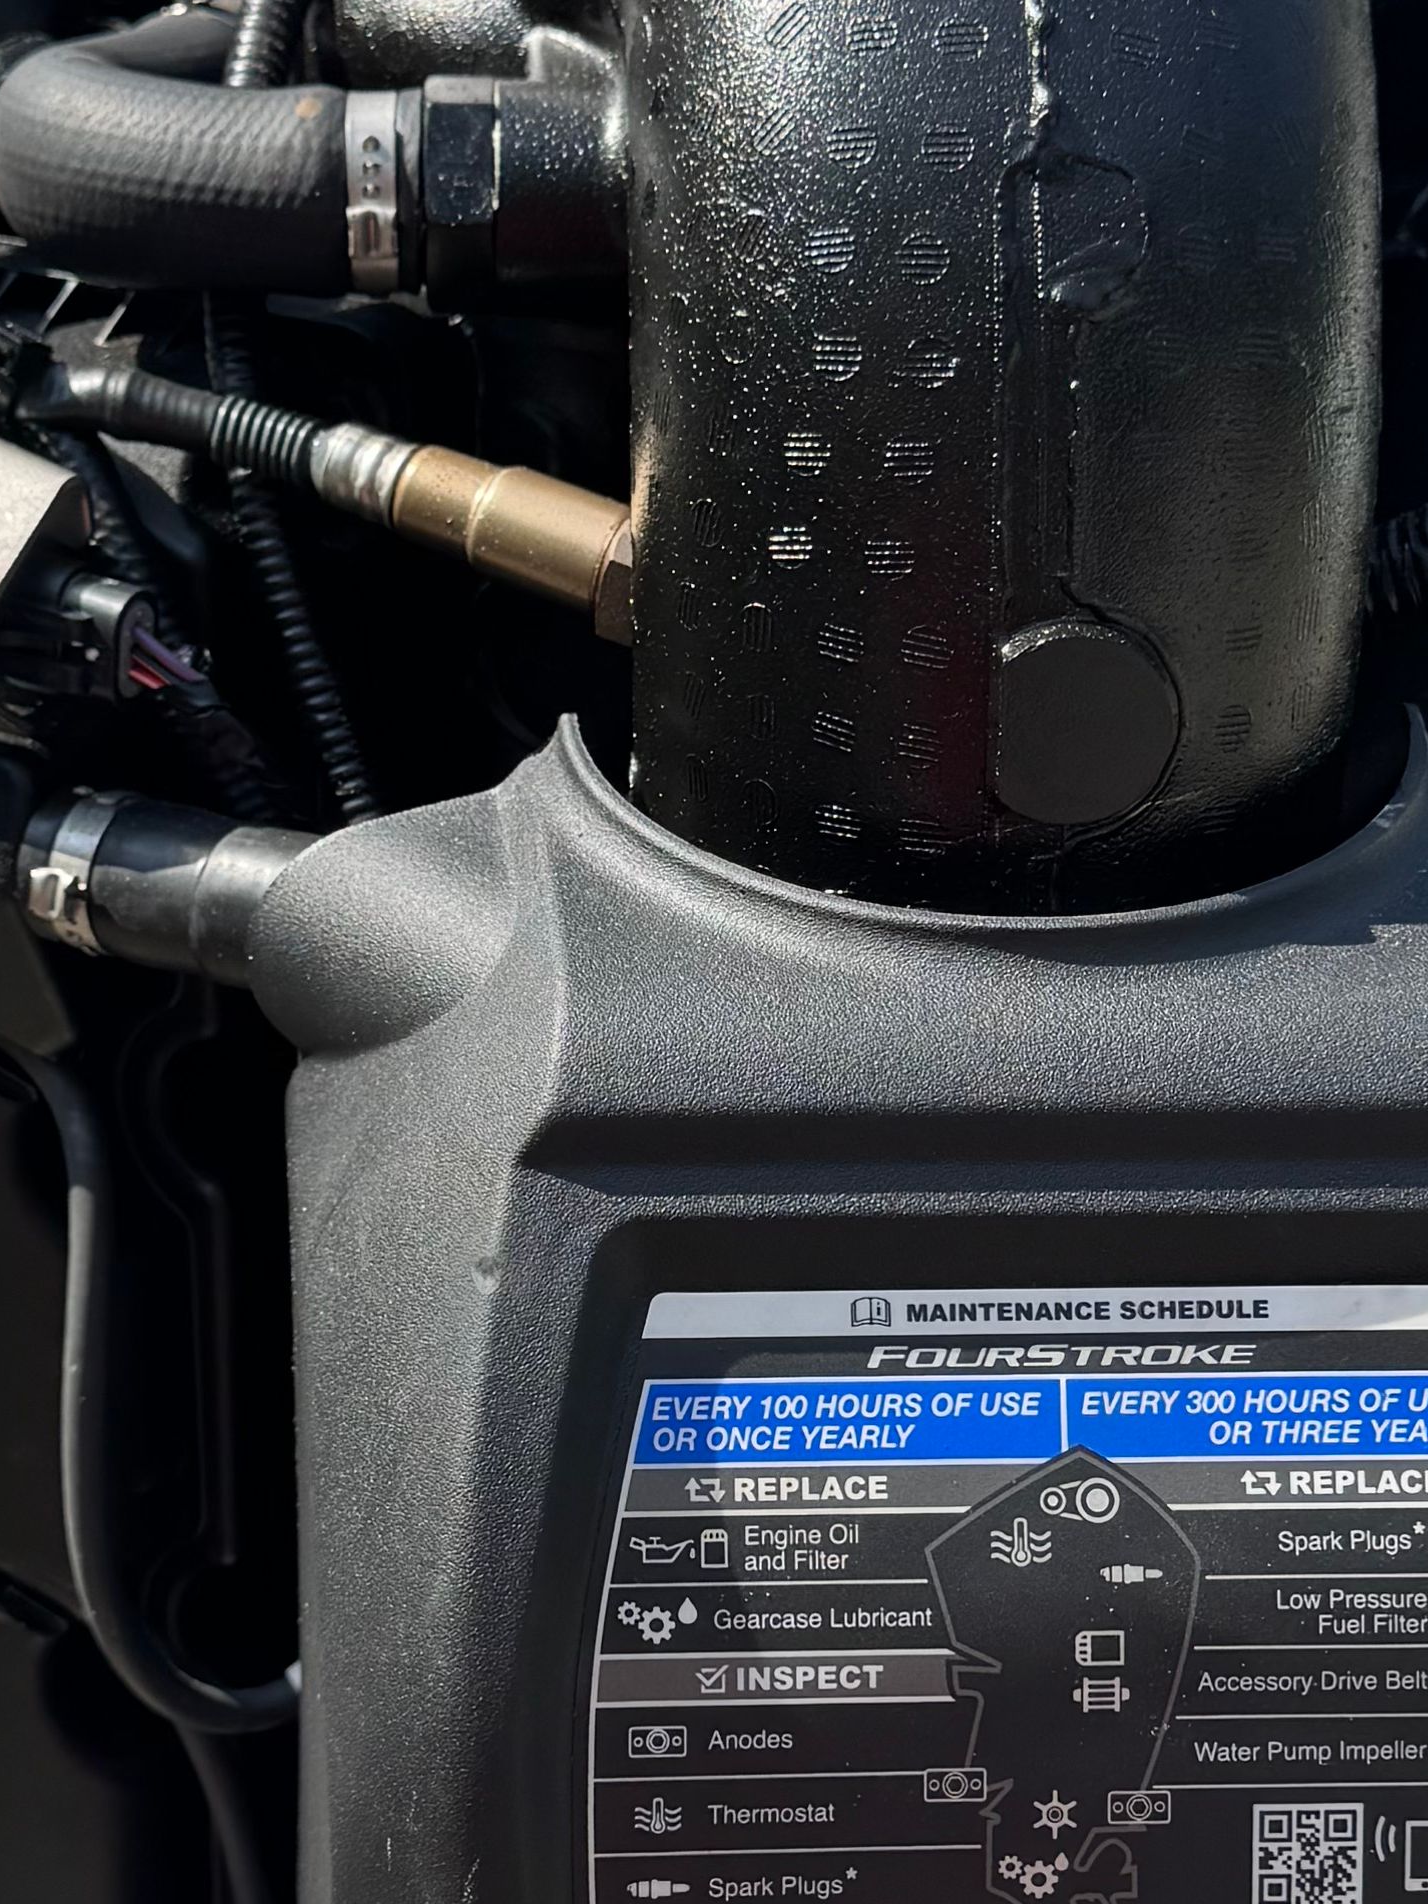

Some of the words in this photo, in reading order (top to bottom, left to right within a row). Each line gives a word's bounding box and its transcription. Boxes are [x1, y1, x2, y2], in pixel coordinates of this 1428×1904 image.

[907, 1300, 1109, 1322] MAINTENANCE
[1120, 1300, 1269, 1319] SCHEDULE
[652, 1396, 751, 1420] EVERY
[760, 1396, 807, 1419] 100
[815, 1394, 922, 1418] HOURS
[931, 1393, 972, 1416] OF
[980, 1392, 1041, 1416] USE
[1082, 1391, 1180, 1415] EVERY
[1185, 1390, 1235, 1414] 300
[1243, 1390, 1350, 1413] HOURS
[1360, 1389, 1401, 1412] OF
[654, 1428, 697, 1451] OR
[706, 1426, 792, 1451] ONCE
[802, 1425, 915, 1449] YEARLY
[1209, 1422, 1252, 1445] OR
[1261, 1420, 1362, 1444] THREE
[734, 1476, 888, 1502] REPLACE
[745, 1525, 821, 1549] Engine
[829, 1524, 859, 1544] Oil
[1278, 1531, 1342, 1555] Spark
[745, 1551, 786, 1571] and
[794, 1550, 848, 1570] Filter
[1276, 1590, 1321, 1610] Low
[1330, 1589, 1428, 1609] Pressure
[714, 1609, 822, 1630] Gearcase
[830, 1607, 932, 1628] Lubricant
[1319, 1615, 1365, 1634] Fuel
[1374, 1614, 1428, 1633] Filter
[737, 1665, 883, 1691] INSPECT
[1198, 1673, 1313, 1695] Accessory
[1321, 1671, 1377, 1690] Drive
[1386, 1671, 1428, 1689] Belt
[709, 1730, 793, 1749] Anodes
[1194, 1742, 1260, 1762] Water
[1268, 1742, 1331, 1765] Pump
[1341, 1741, 1426, 1764] Impeller
[708, 1804, 835, 1824] Thermostat
[709, 1878, 774, 1902] Spark
